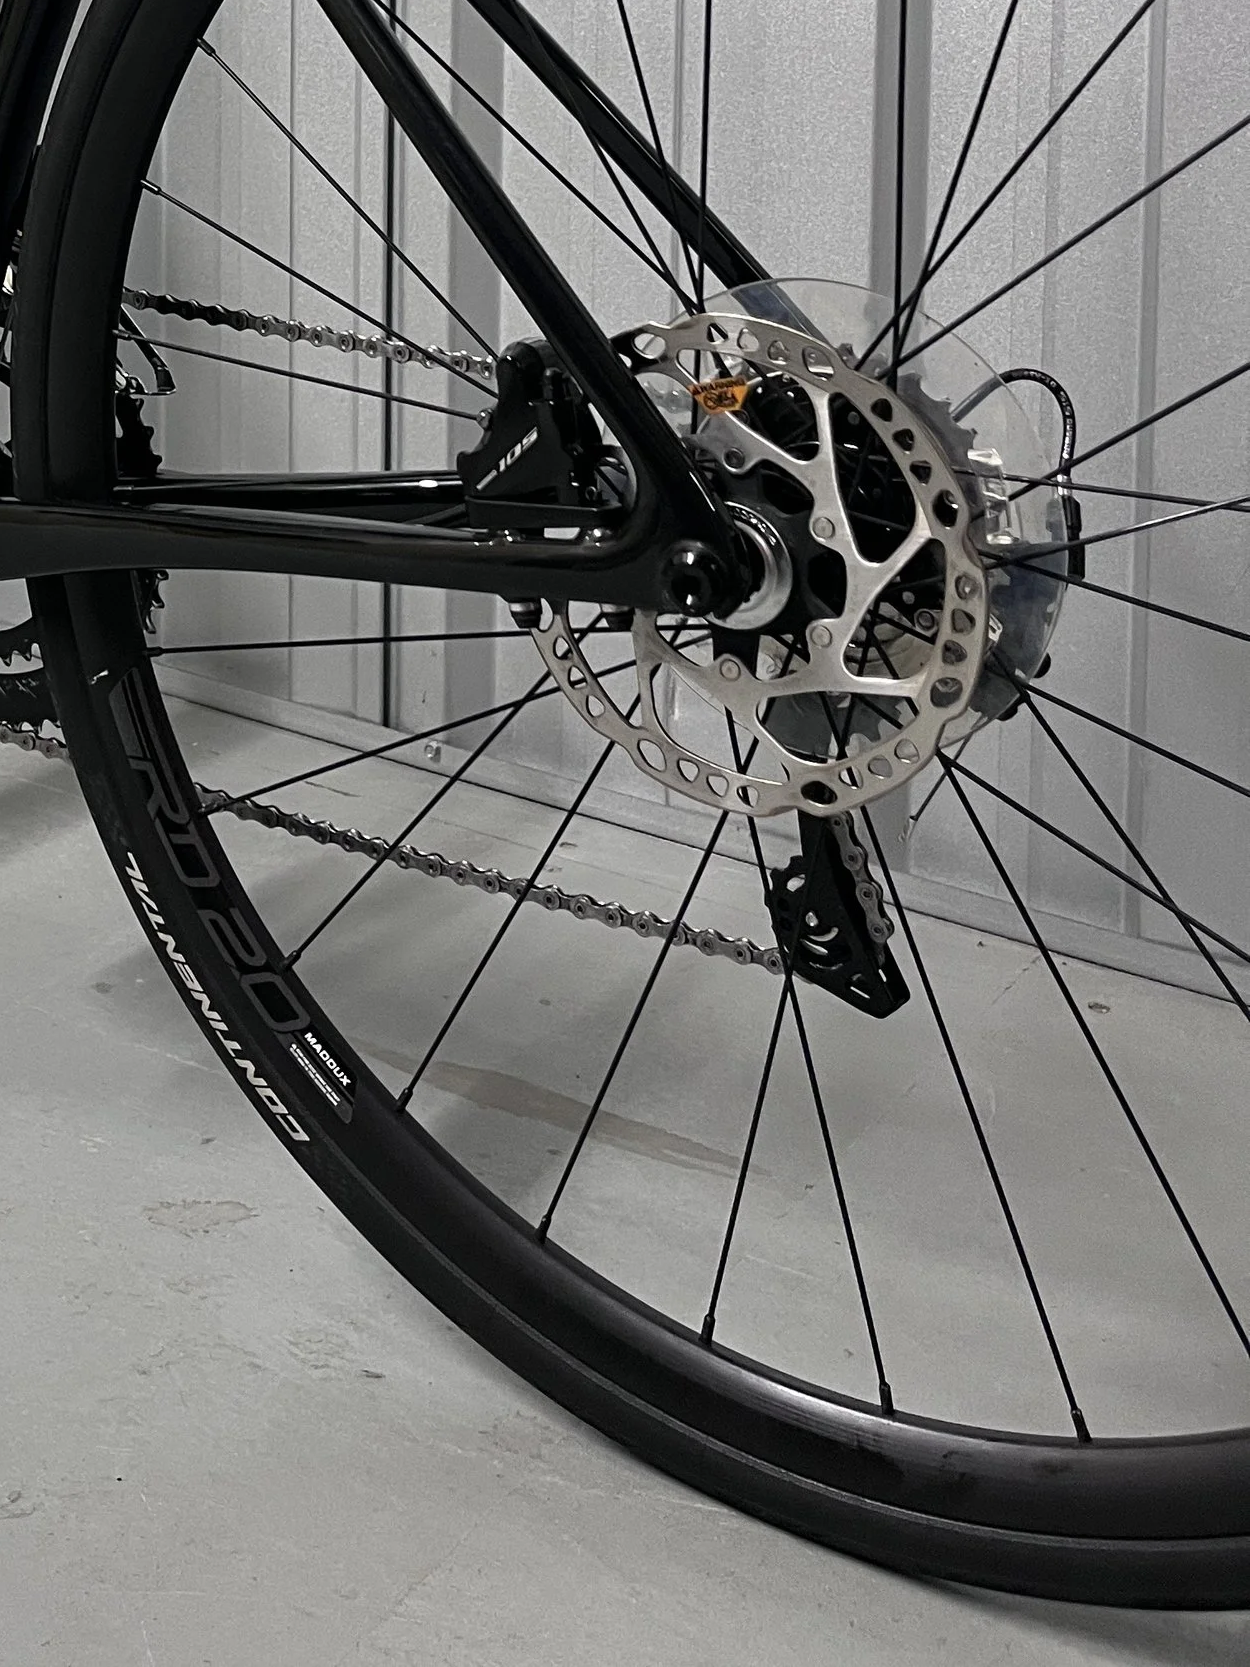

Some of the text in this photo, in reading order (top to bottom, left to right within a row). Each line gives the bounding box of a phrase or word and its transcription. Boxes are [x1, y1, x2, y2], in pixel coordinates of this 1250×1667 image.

[498, 426, 538, 472] 105
[122, 730, 311, 1033] RD 20
[126, 851, 310, 1142] CONTINENTAL
[304, 1032, 352, 1087] MADDUX
